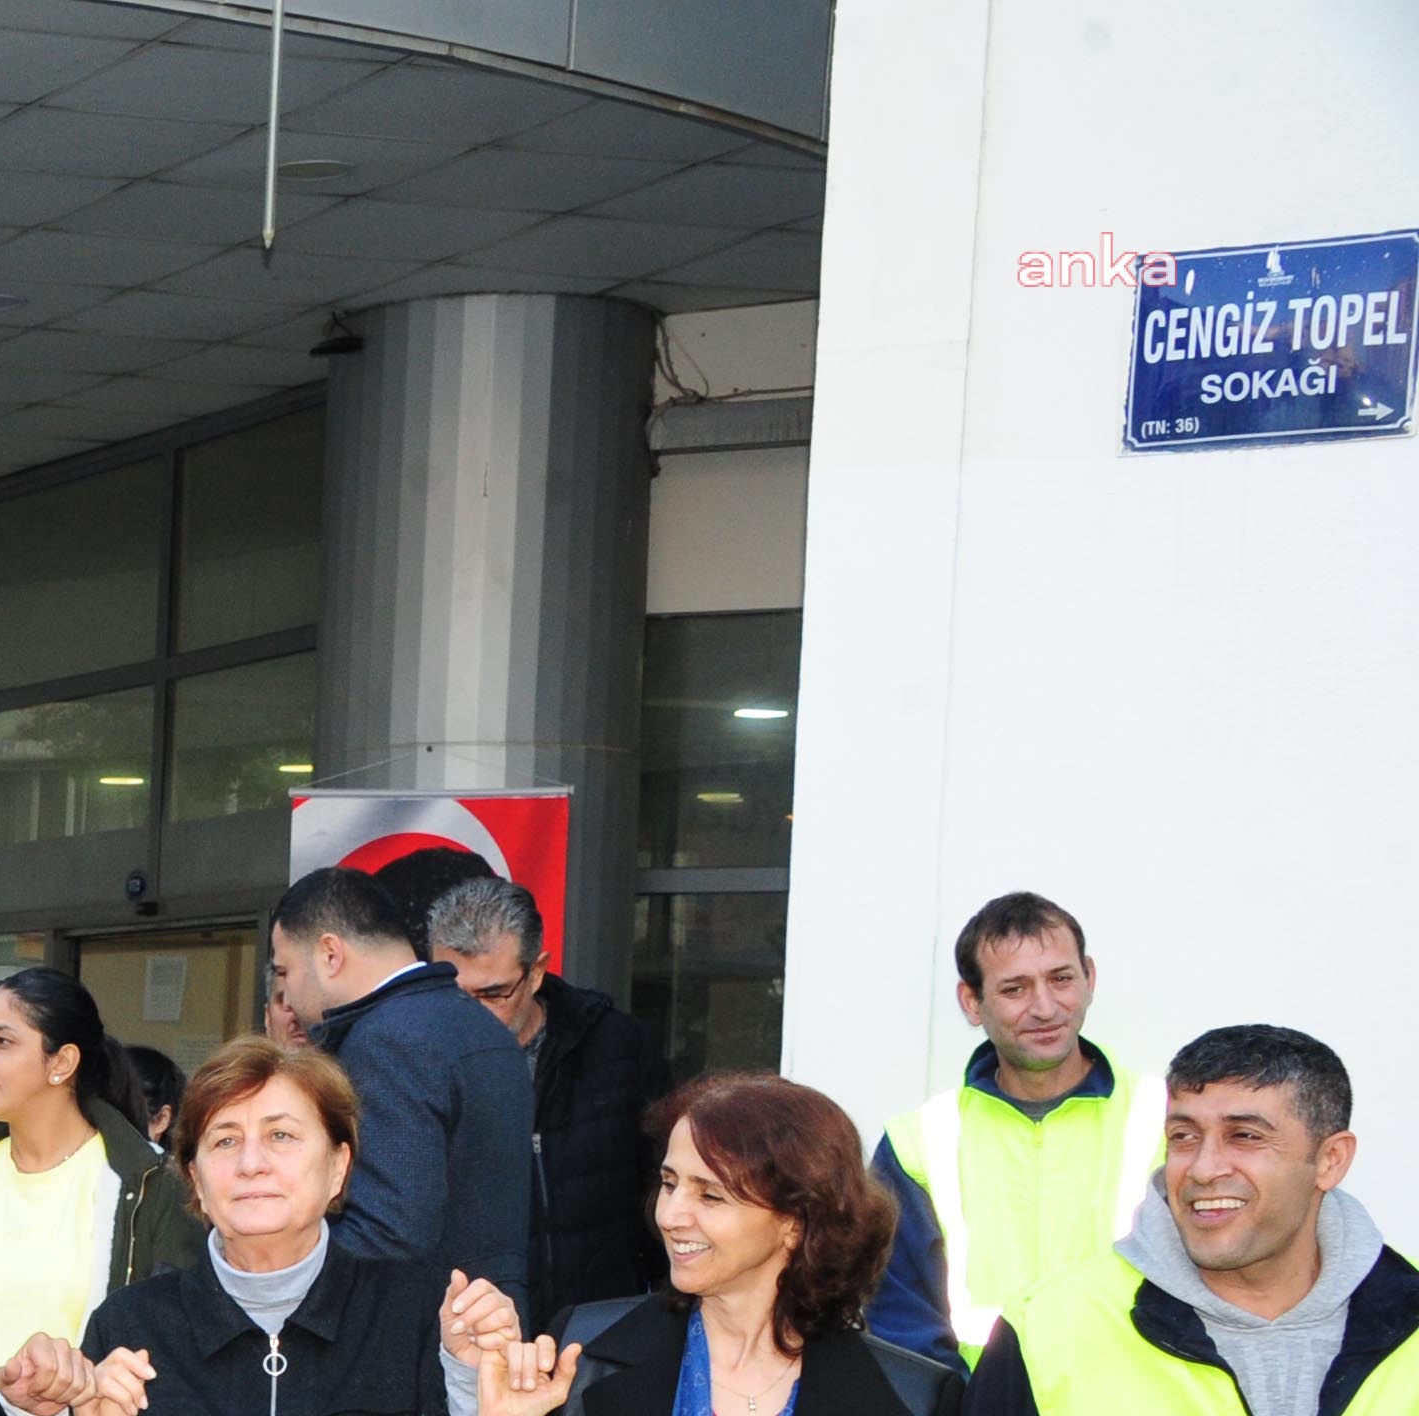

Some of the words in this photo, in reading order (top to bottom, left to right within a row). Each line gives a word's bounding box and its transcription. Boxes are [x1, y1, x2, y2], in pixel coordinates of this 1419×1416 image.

[1143, 291, 1277, 365] CENGİZ
[1288, 290, 1407, 352] TOPEL
[1200, 358, 1338, 405] SOKAĞI
[1141, 420, 1171, 439] (TN:
[1175, 416, 1200, 434] 36)
